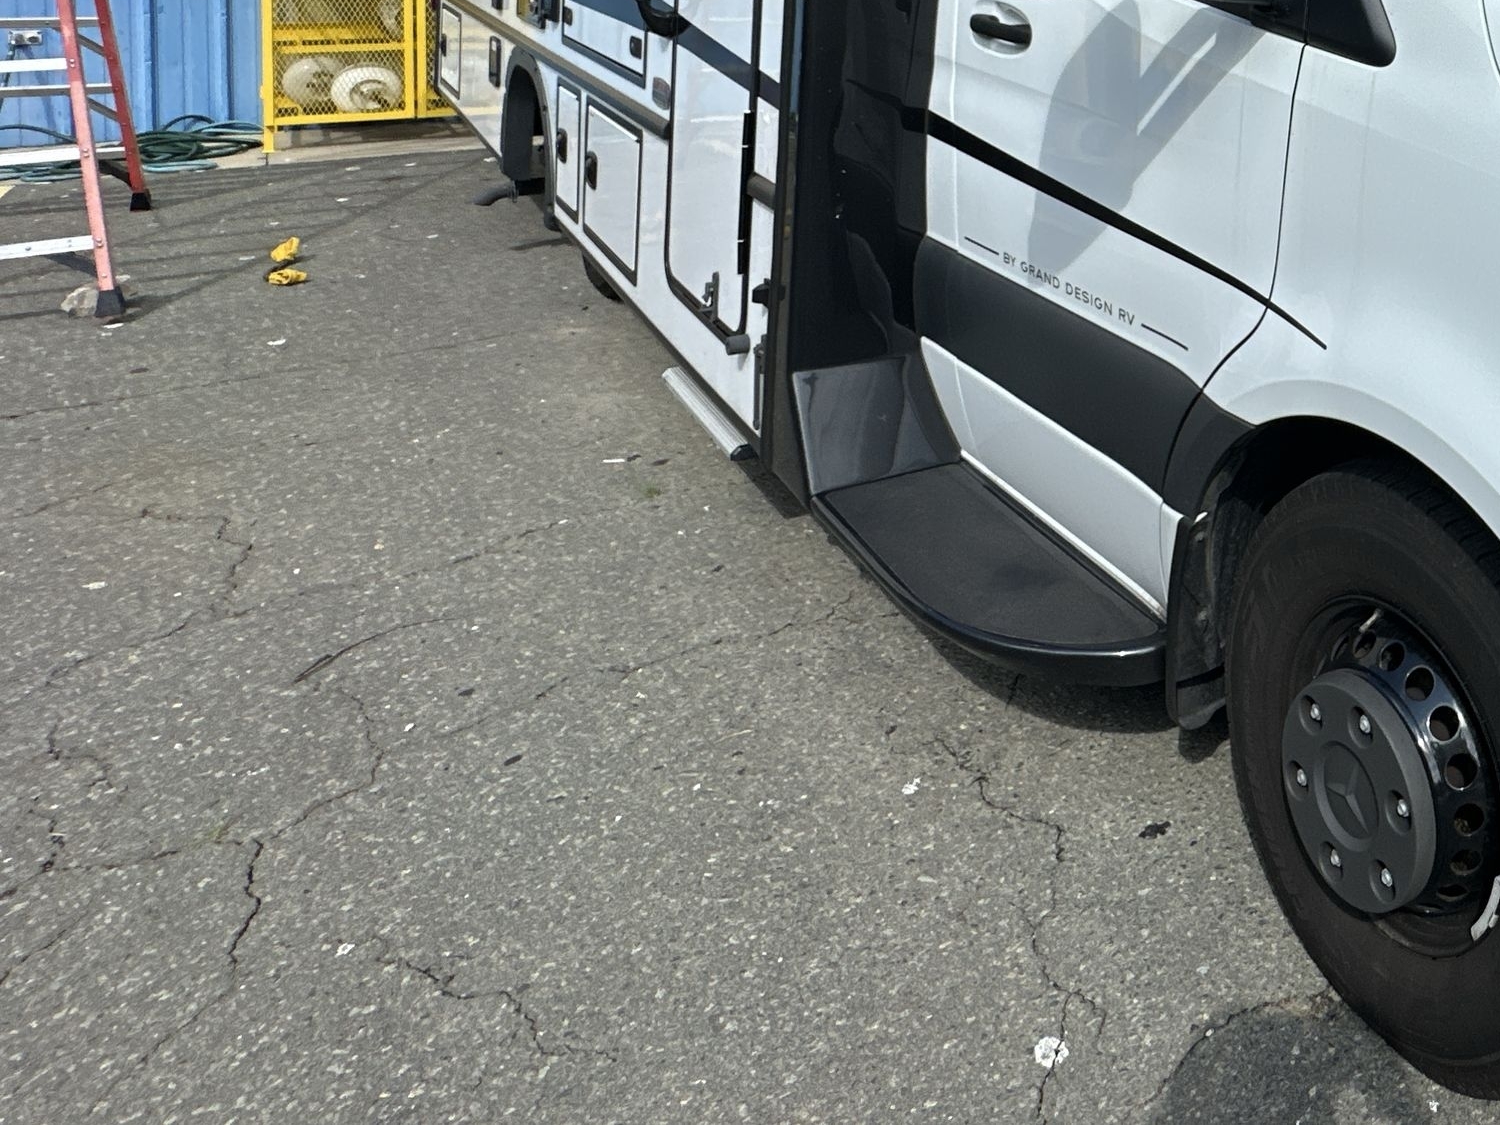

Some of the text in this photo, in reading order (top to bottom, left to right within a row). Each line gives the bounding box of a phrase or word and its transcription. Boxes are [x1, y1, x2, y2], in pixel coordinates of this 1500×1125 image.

[1003, 252, 1135, 325] BY GRAND DESIGN RV
